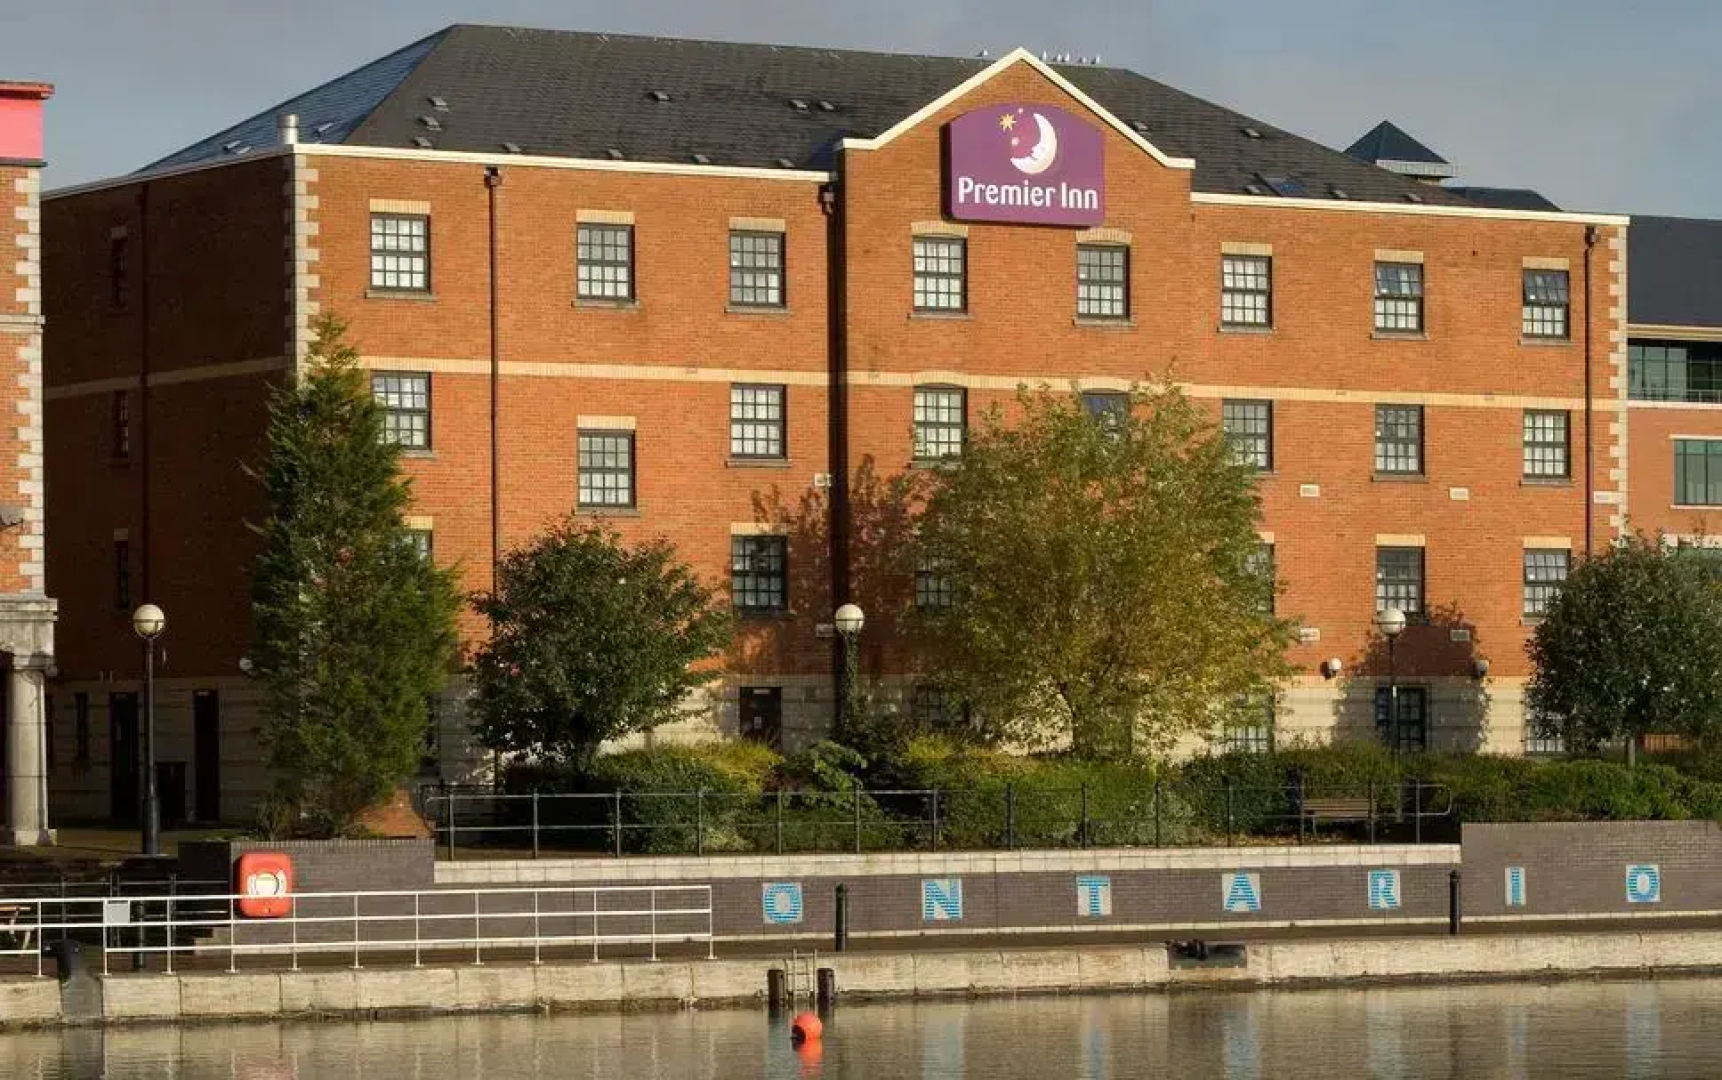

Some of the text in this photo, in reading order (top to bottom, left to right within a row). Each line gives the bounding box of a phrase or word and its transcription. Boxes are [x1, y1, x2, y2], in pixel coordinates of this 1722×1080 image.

[958, 177, 1099, 210] Premier Inn
[762, 865, 1661, 923] ONTARIO
